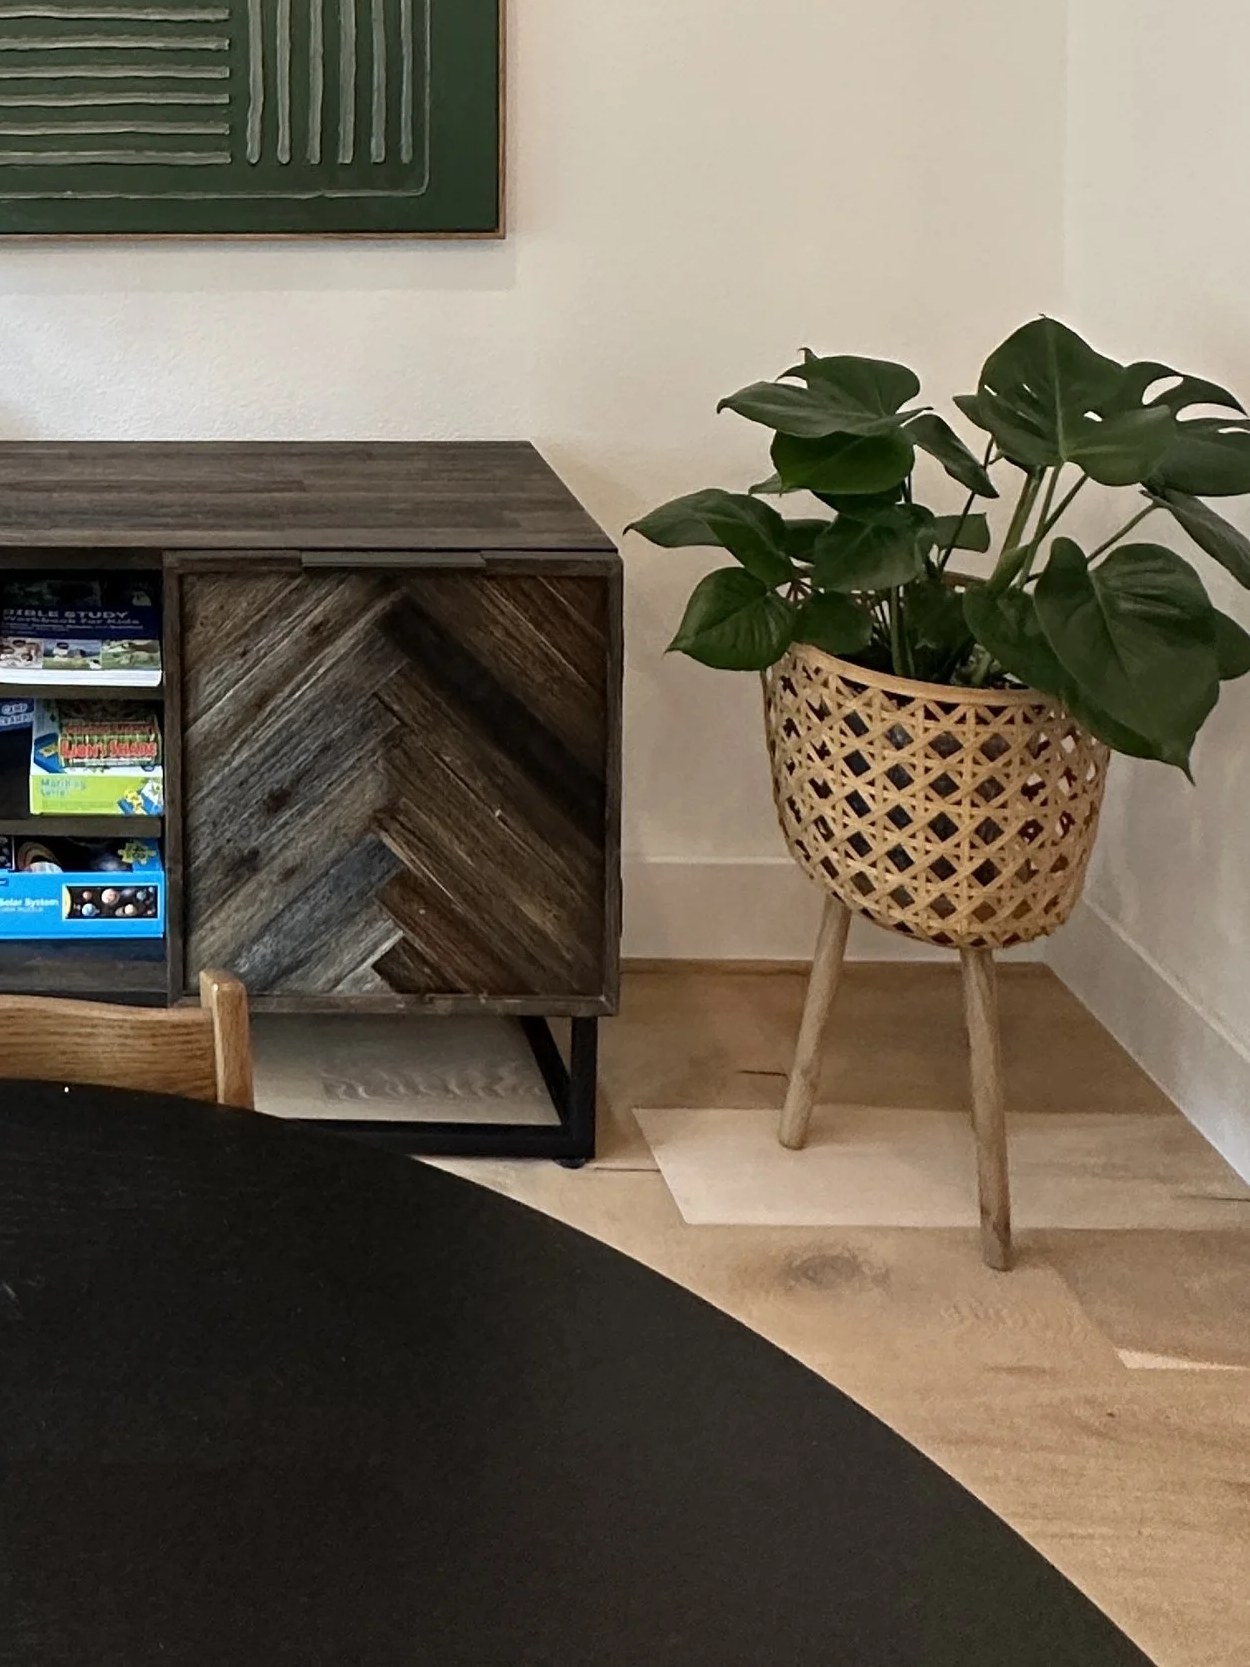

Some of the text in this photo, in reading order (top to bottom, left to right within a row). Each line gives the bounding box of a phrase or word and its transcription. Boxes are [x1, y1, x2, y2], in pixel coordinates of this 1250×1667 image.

[3, 609, 129, 619] BIBLE STUDY
[2, 616, 76, 624] Workbook
[24, 897, 60, 909] System
